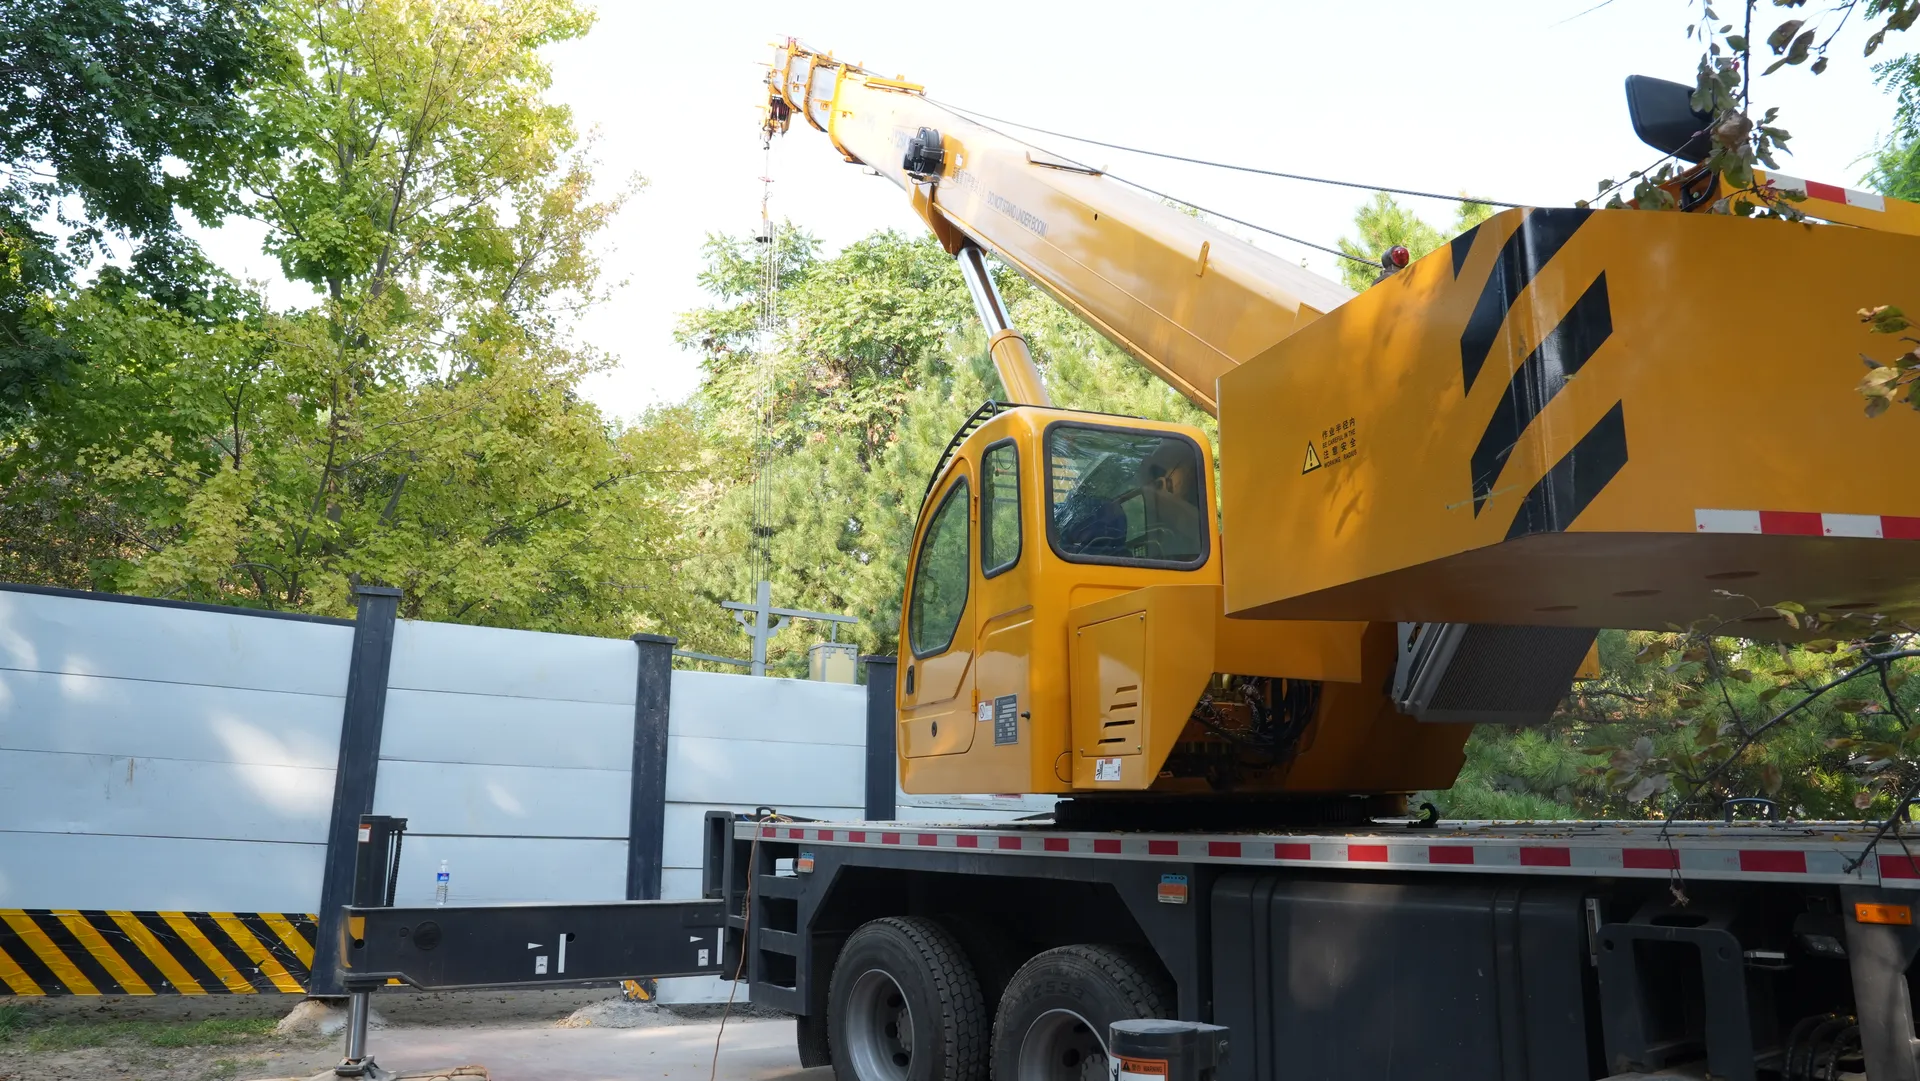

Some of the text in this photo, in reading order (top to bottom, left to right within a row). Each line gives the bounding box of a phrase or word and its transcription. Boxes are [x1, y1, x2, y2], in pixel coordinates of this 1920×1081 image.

[1323, 417, 1355, 439] 作业半径内
[1328, 435, 1343, 446] CAREFUL
[1324, 438, 1356, 459] 注意安全
[1324, 457, 1341, 468] WORKING
[1142, 1065, 1163, 1073] WARNING
